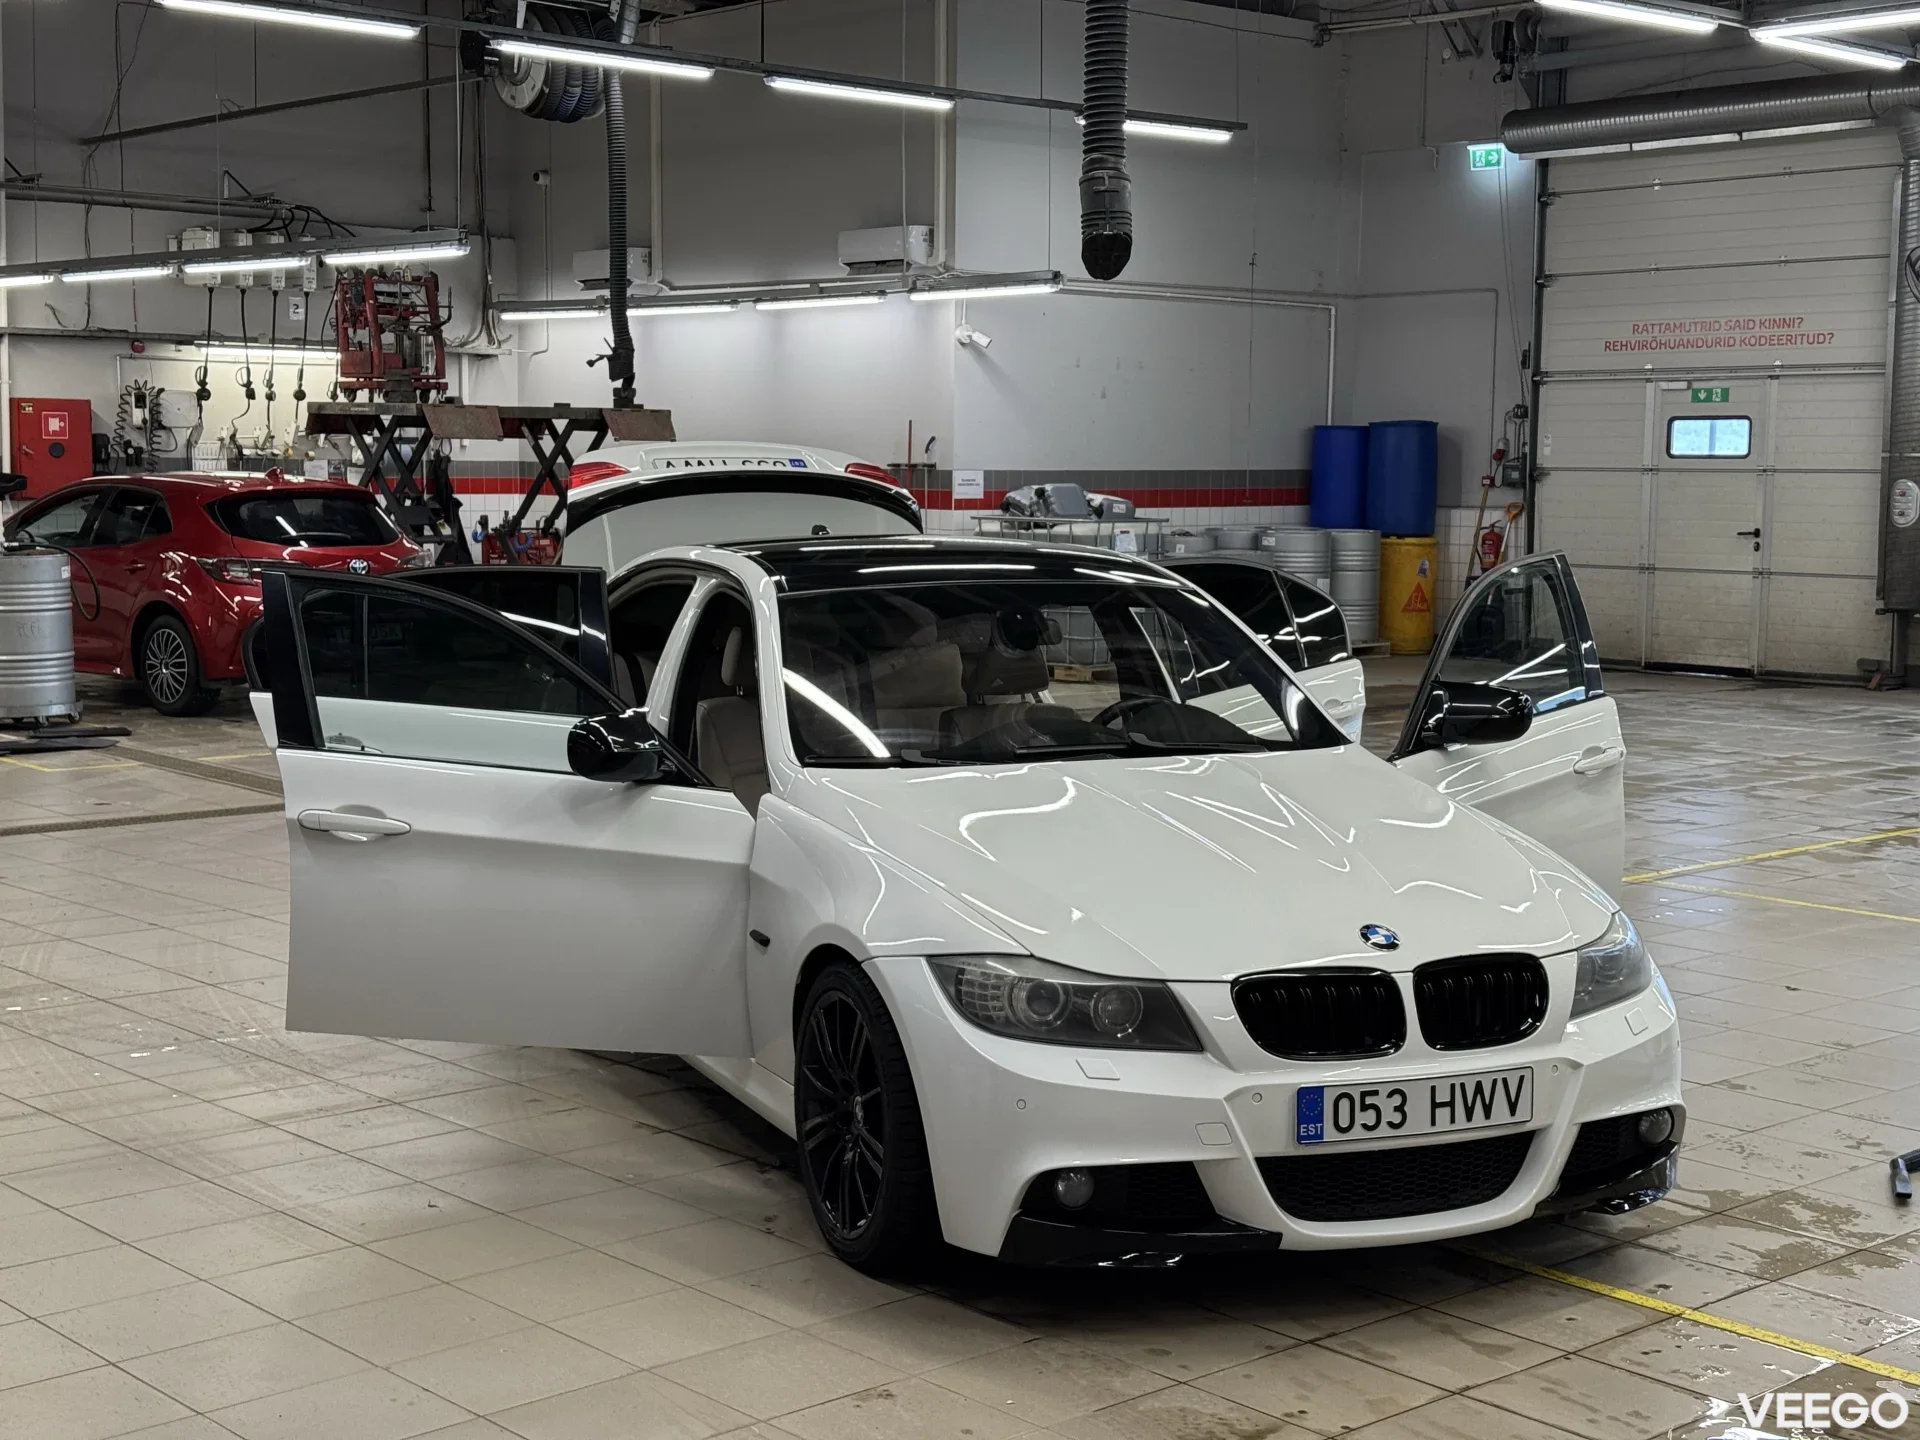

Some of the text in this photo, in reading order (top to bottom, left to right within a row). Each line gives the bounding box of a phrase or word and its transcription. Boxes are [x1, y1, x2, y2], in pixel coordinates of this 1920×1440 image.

[292, 303, 300, 315] 2
[1632, 317, 1804, 335] RATTAMUTRID SAID KINNI?
[1604, 333, 1834, 352] REHVIRÕHUANDURID KODEERITUD?
[1300, 1075, 1526, 1136] EST 053 HWV
